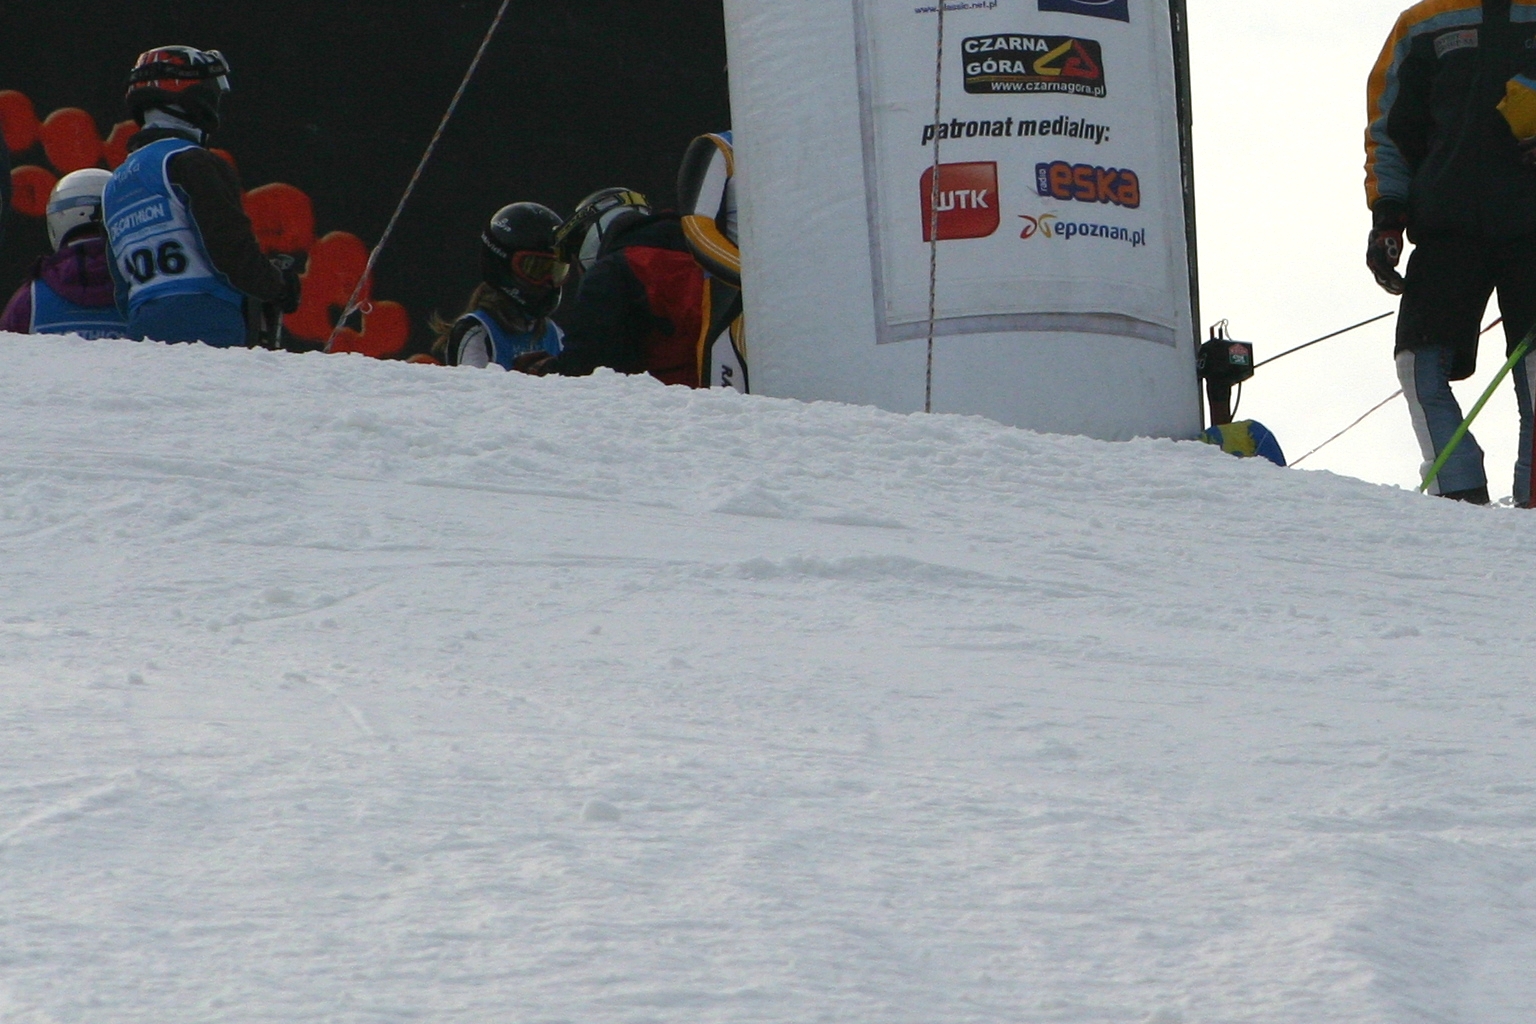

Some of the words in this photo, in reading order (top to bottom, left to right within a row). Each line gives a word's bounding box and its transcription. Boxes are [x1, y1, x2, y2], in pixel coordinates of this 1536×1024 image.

[964, 37, 1049, 53] CZARNA
[966, 57, 1026, 75] GÓRA
[991, 80, 1105, 96] www.czarnagora.pl
[921, 117, 1013, 145] patronat
[1017, 115, 1110, 144] medialny:
[1050, 161, 1139, 206] eska
[1054, 221, 1146, 247] epoznan.pl
